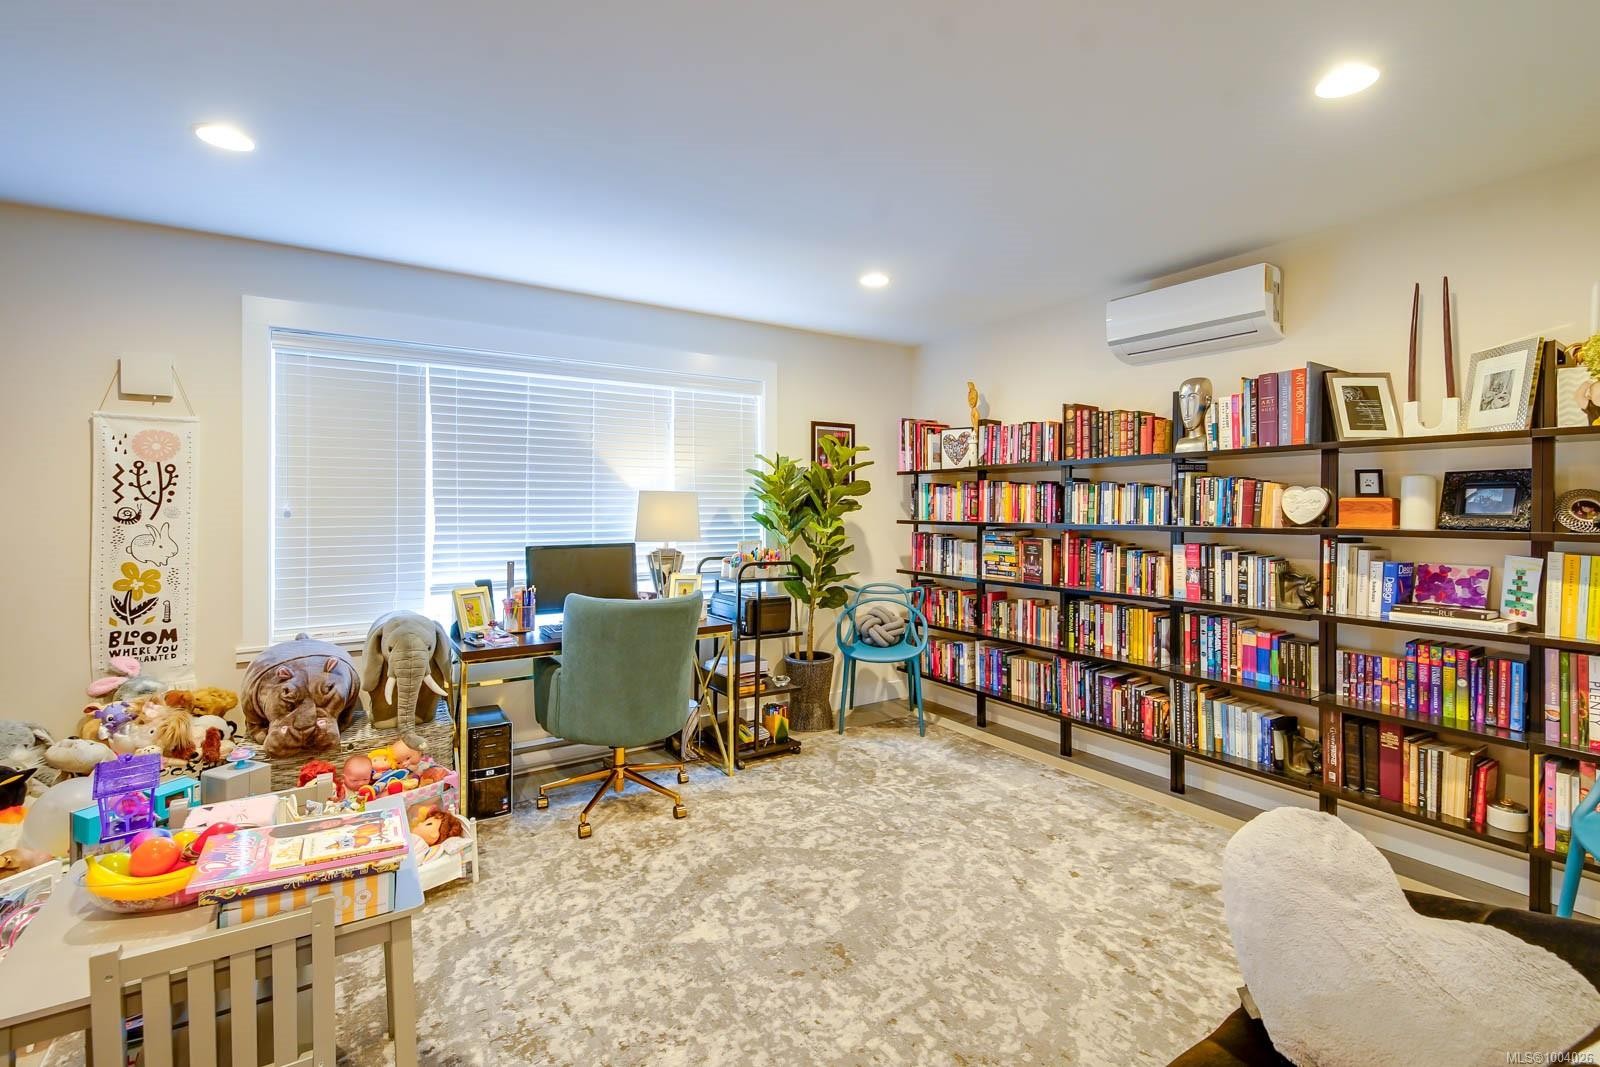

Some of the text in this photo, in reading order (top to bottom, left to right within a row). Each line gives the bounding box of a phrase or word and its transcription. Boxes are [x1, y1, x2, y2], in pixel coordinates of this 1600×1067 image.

[1296, 372, 1305, 415] ART HISTORY
[1383, 577, 1395, 604] Design
[108, 628, 178, 648] BLOOM
[109, 645, 178, 657] WHERE YOU
